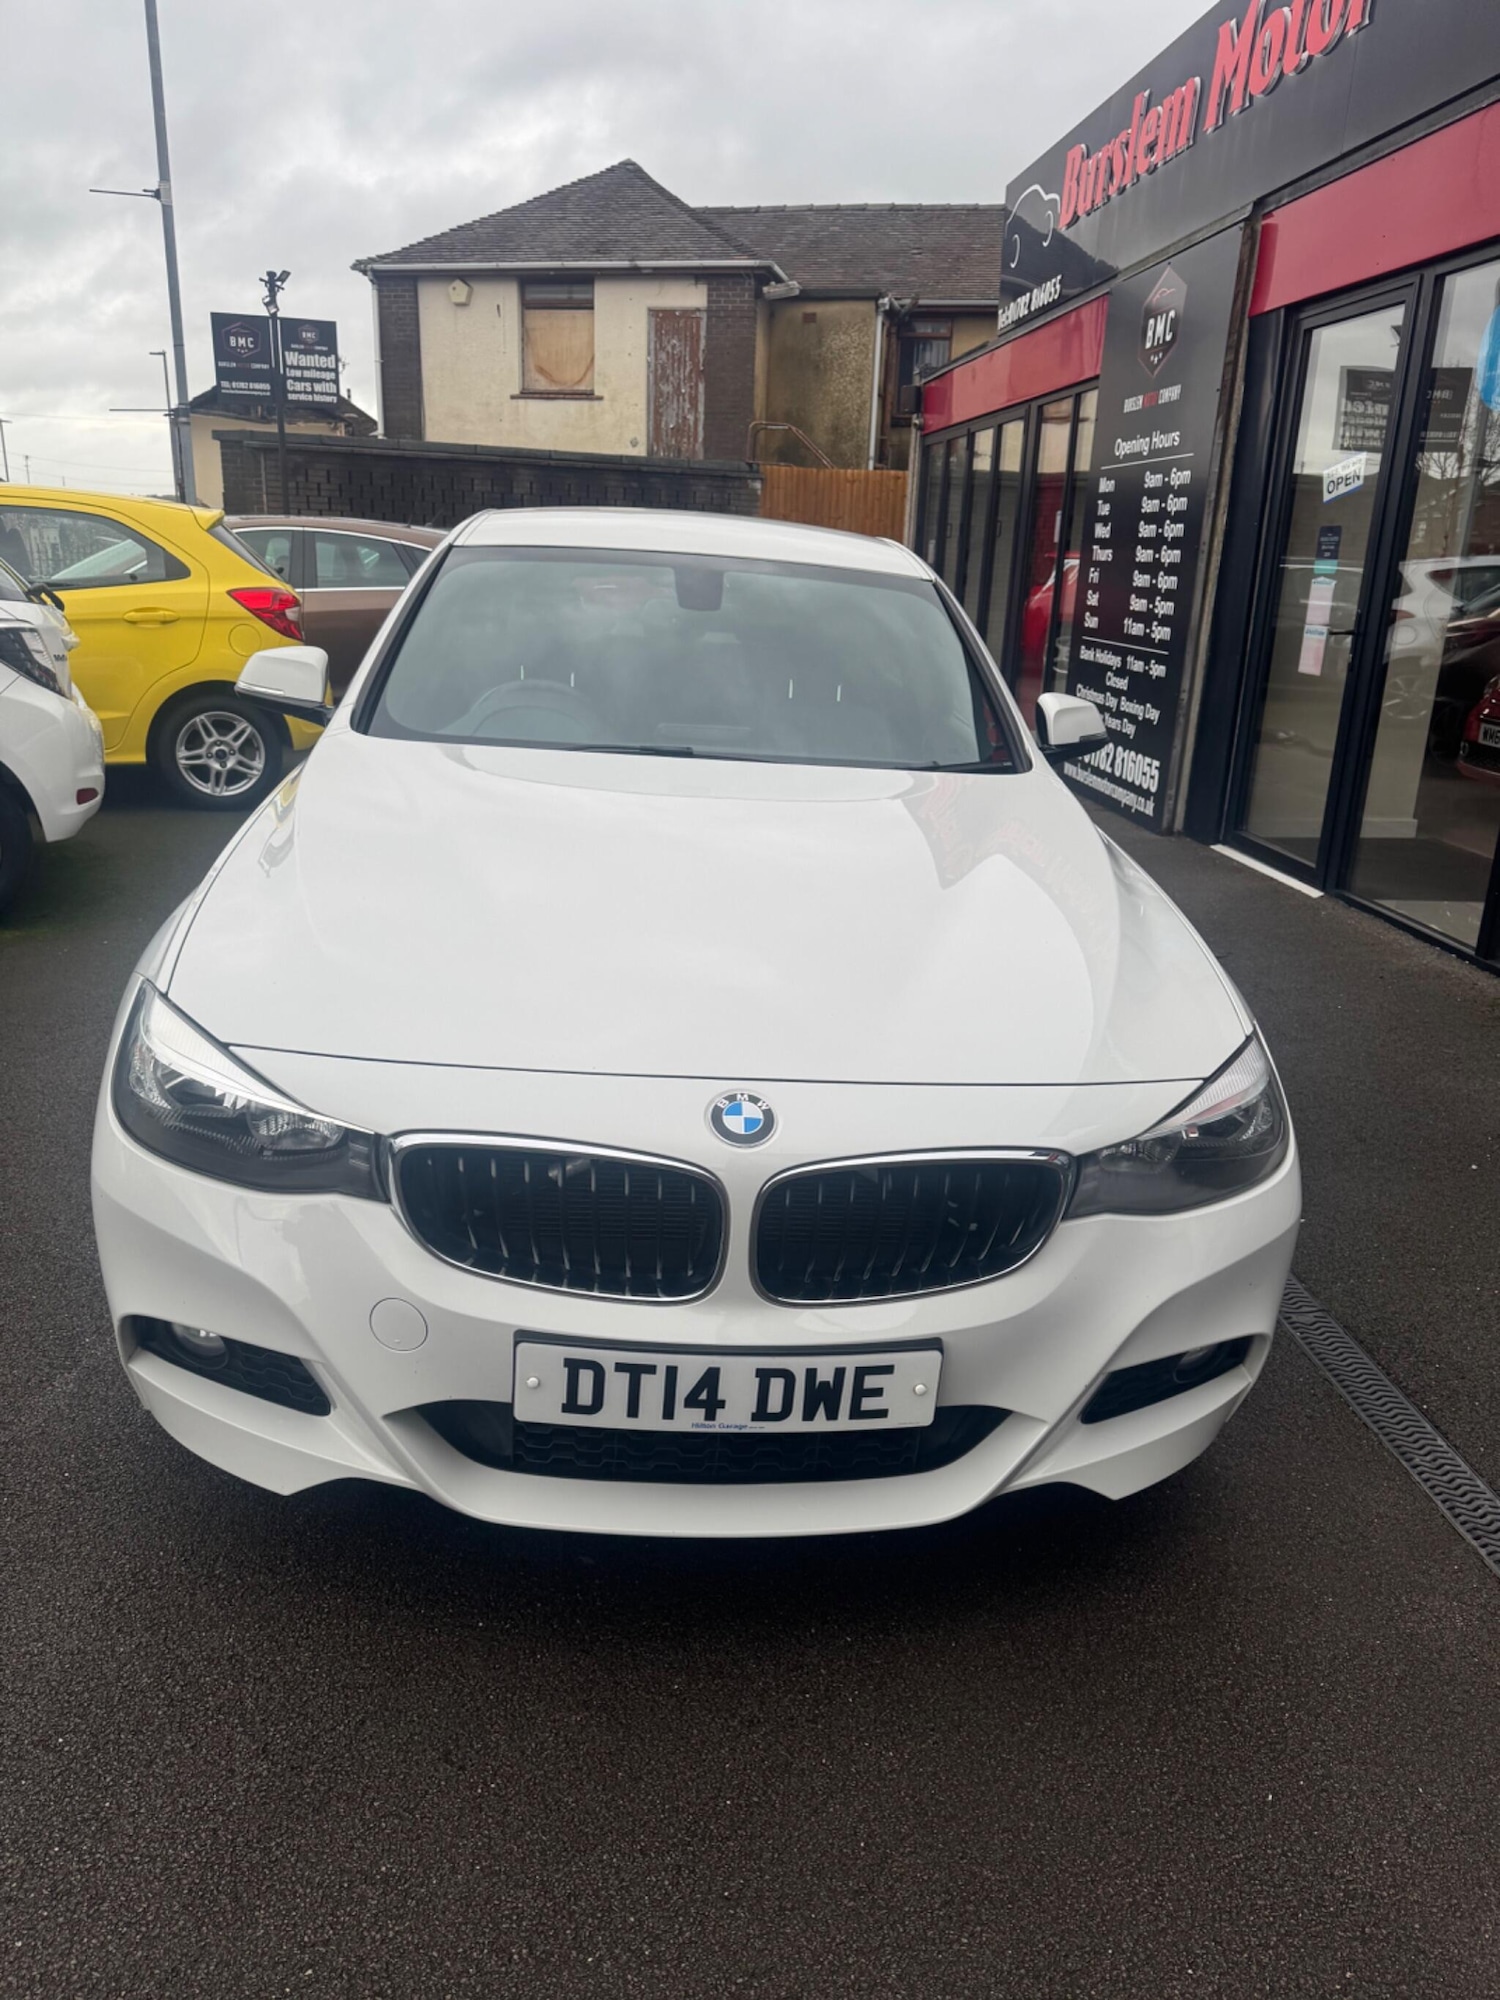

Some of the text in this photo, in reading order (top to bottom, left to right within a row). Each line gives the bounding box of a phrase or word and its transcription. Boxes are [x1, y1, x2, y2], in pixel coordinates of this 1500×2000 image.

[1058, 77, 1200, 230] Burslem
[229, 336, 254, 348] BMC
[1145, 309, 1175, 349] BMC
[285, 351, 336, 369] Wanted
[286, 367, 336, 380] Low mileage
[287, 379, 337, 393] Cars with
[287, 393, 338, 404] service history
[1114, 430, 1181, 459] Opening Hours
[1098, 477, 1116, 493] Mon
[1144, 471, 1163, 488] 9am
[1170, 467, 1191, 490] 6pm
[1328, 467, 1360, 494] OPEN
[1097, 500, 1111, 516] Tue
[1141, 496, 1160, 513] 9am
[1166, 494, 1188, 515] 6pm
[1094, 522, 1111, 539] Wed
[1138, 520, 1157, 538] 9am
[1163, 519, 1185, 542] 6pm
[1092, 545, 1114, 562] Thurs
[1135, 545, 1154, 563] 9am
[1160, 545, 1182, 567] 6pm
[1088, 567, 1100, 584] Fri
[1132, 570, 1151, 588] 9am
[1157, 571, 1179, 593] 6pm
[1086, 589, 1100, 607] Sat
[1129, 593, 1148, 612] 9am
[1154, 596, 1175, 618] 5pm
[1084, 611, 1099, 629] Sun
[1123, 617, 1145, 637] 11am
[1151, 621, 1172, 643] 5pm
[1079, 645, 1095, 662] Bank
[1095, 649, 1122, 670] Holidays
[1126, 655, 1145, 674] 11am
[1149, 659, 1167, 679] 5pm
[1105, 671, 1129, 691] Closed
[1076, 683, 1105, 704] Christmas
[1105, 692, 1119, 712] Day
[1120, 696, 1144, 721] Boxing
[1145, 703, 1161, 725] Day
[1104, 712, 1121, 731] Years
[1122, 718, 1137, 739] Day
[1114, 745, 1161, 793] 816055
[717, 1093, 769, 1110] BMW
[561, 1357, 895, 1422] DT14 DWE
[718, 1422, 748, 1430] Garage
